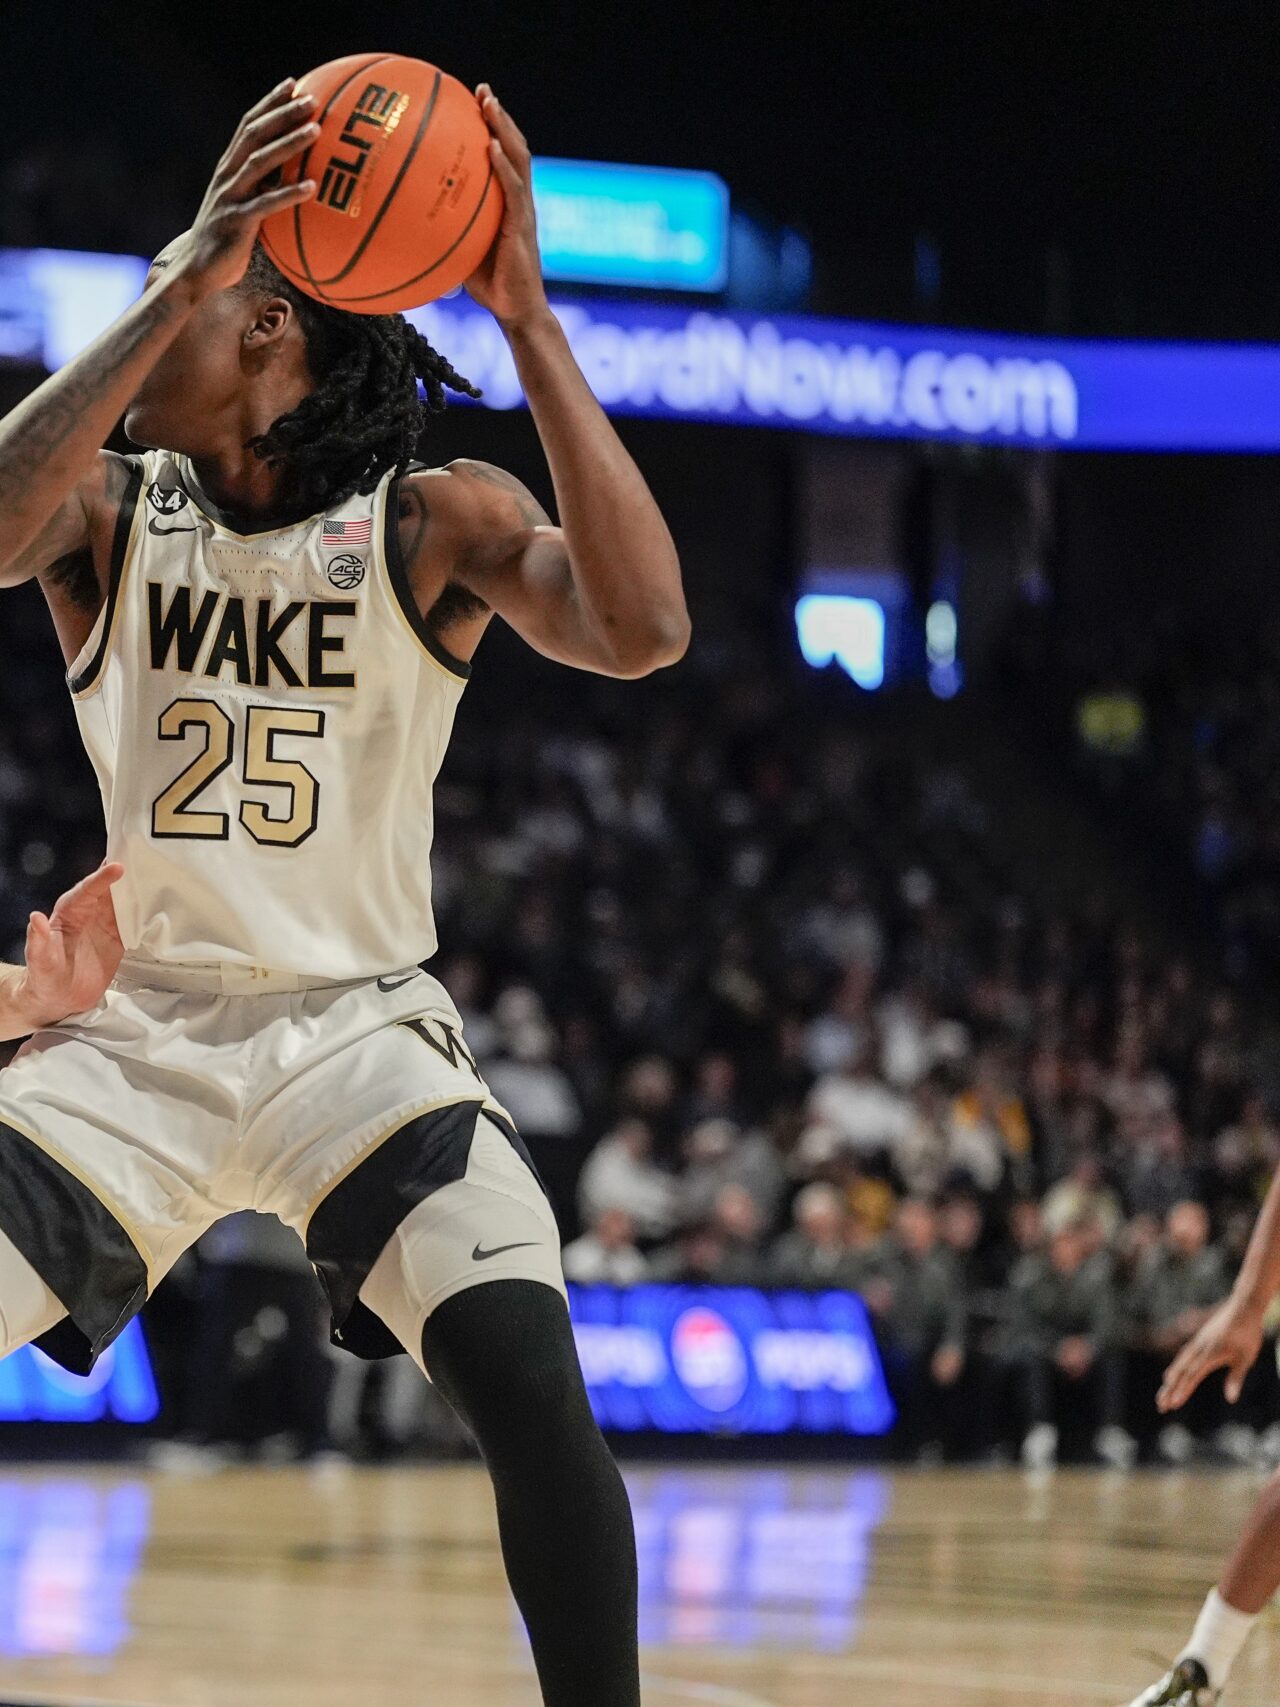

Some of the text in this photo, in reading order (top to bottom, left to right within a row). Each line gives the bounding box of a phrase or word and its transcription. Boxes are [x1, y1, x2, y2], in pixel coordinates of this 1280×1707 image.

[316, 82, 400, 214] ELITE
[151, 483, 182, 510] 54
[332, 565, 362, 574] ACC
[146, 581, 358, 688] WAKE
[151, 697, 326, 848] 25
